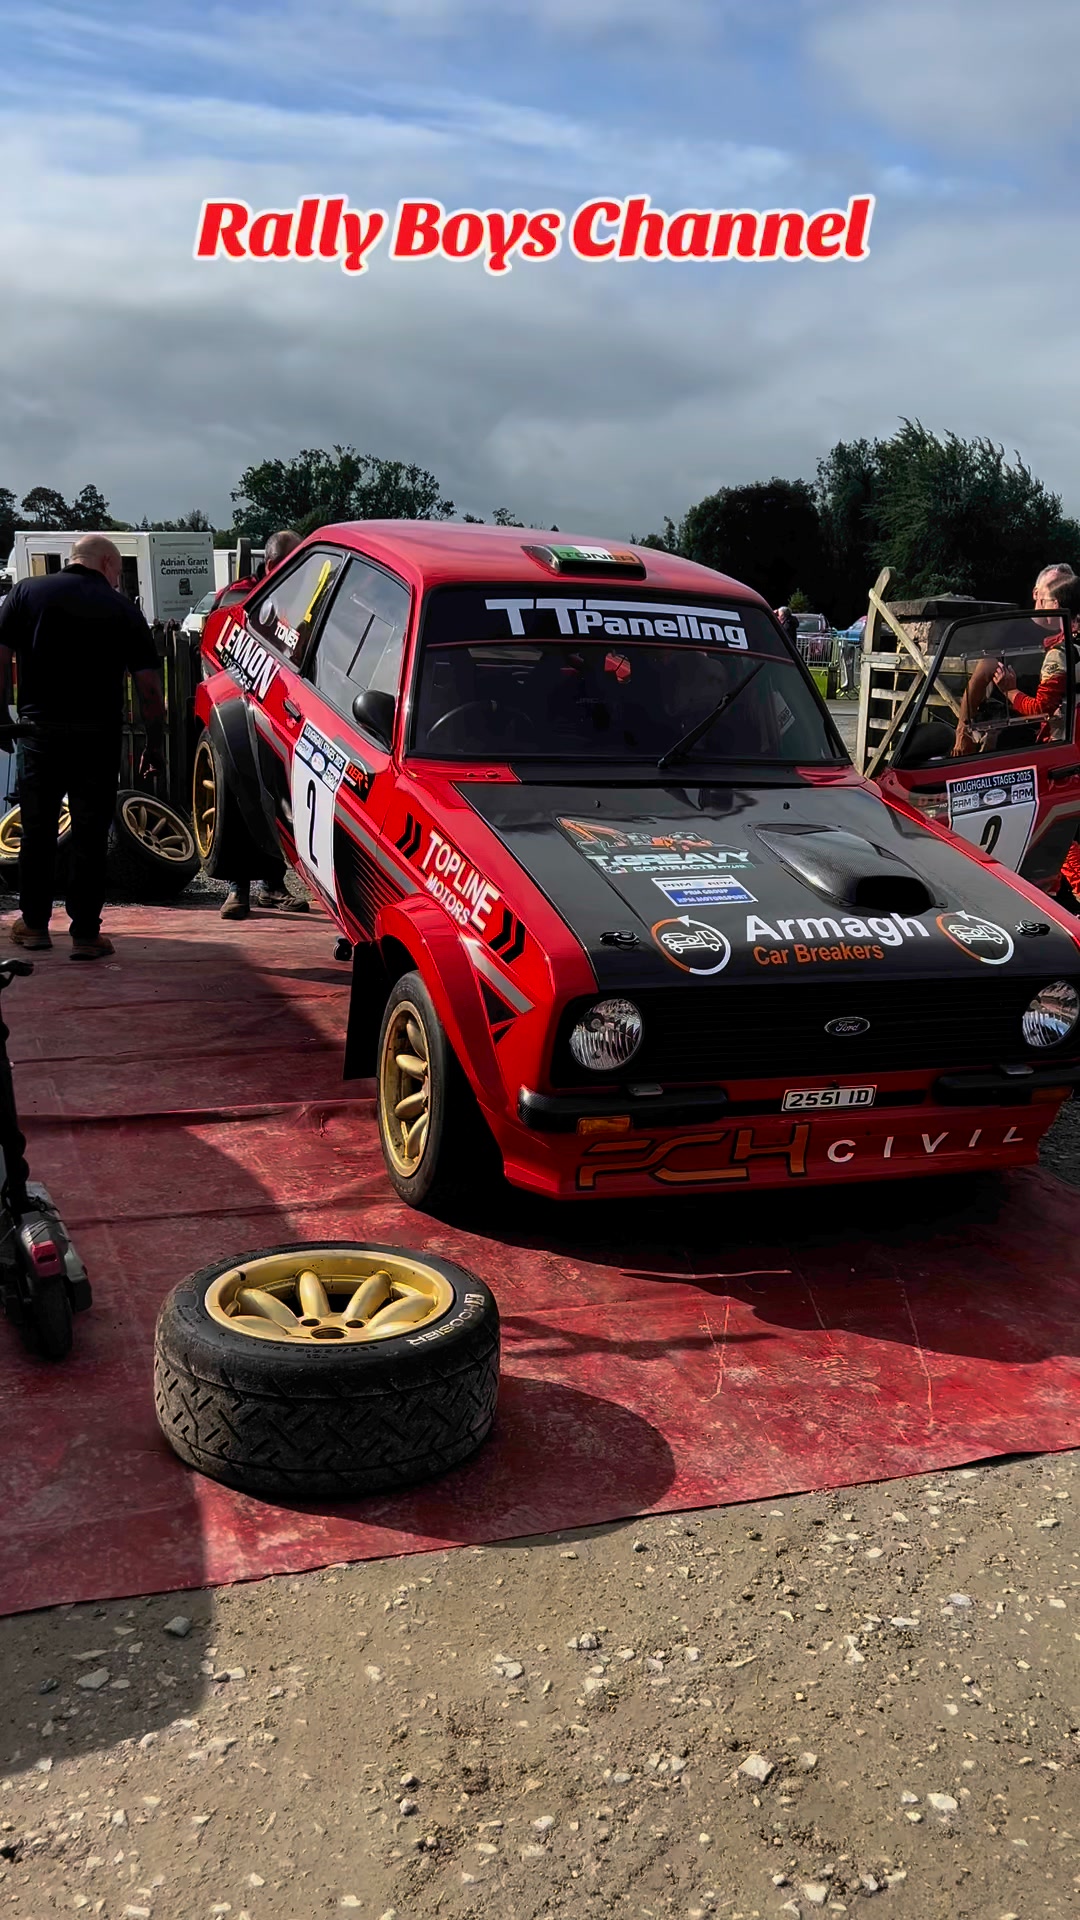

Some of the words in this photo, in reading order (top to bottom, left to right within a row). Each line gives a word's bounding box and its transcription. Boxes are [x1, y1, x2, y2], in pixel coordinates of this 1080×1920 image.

[160, 557, 186, 567] Adrian
[187, 557, 209, 567] Grant
[558, 551, 637, 562] TONER
[160, 566, 209, 576] Commercials
[214, 614, 282, 701] LENNON
[952, 779, 993, 794] LOUGHGALL
[992, 774, 1016, 787] STAGES
[1016, 770, 1032, 782] 2025
[1010, 788, 1034, 800] RPM
[306, 779, 320, 869] 2
[632, 864, 717, 872] CONTRACTS
[420, 829, 501, 932] TOPLINE
[424, 872, 471, 926] MOTORS
[697, 894, 748, 902] MOTORSPORT
[746, 912, 931, 946] Armagh
[753, 945, 789, 966] Car
[793, 942, 885, 963] Breakers
[835, 1020, 861, 1032] Ford
[789, 1091, 841, 1107] 2551
[848, 1089, 870, 1104] ID
[826, 1126, 1025, 1163] CIVIL
[406, 1303, 480, 1346] HOOSIER
